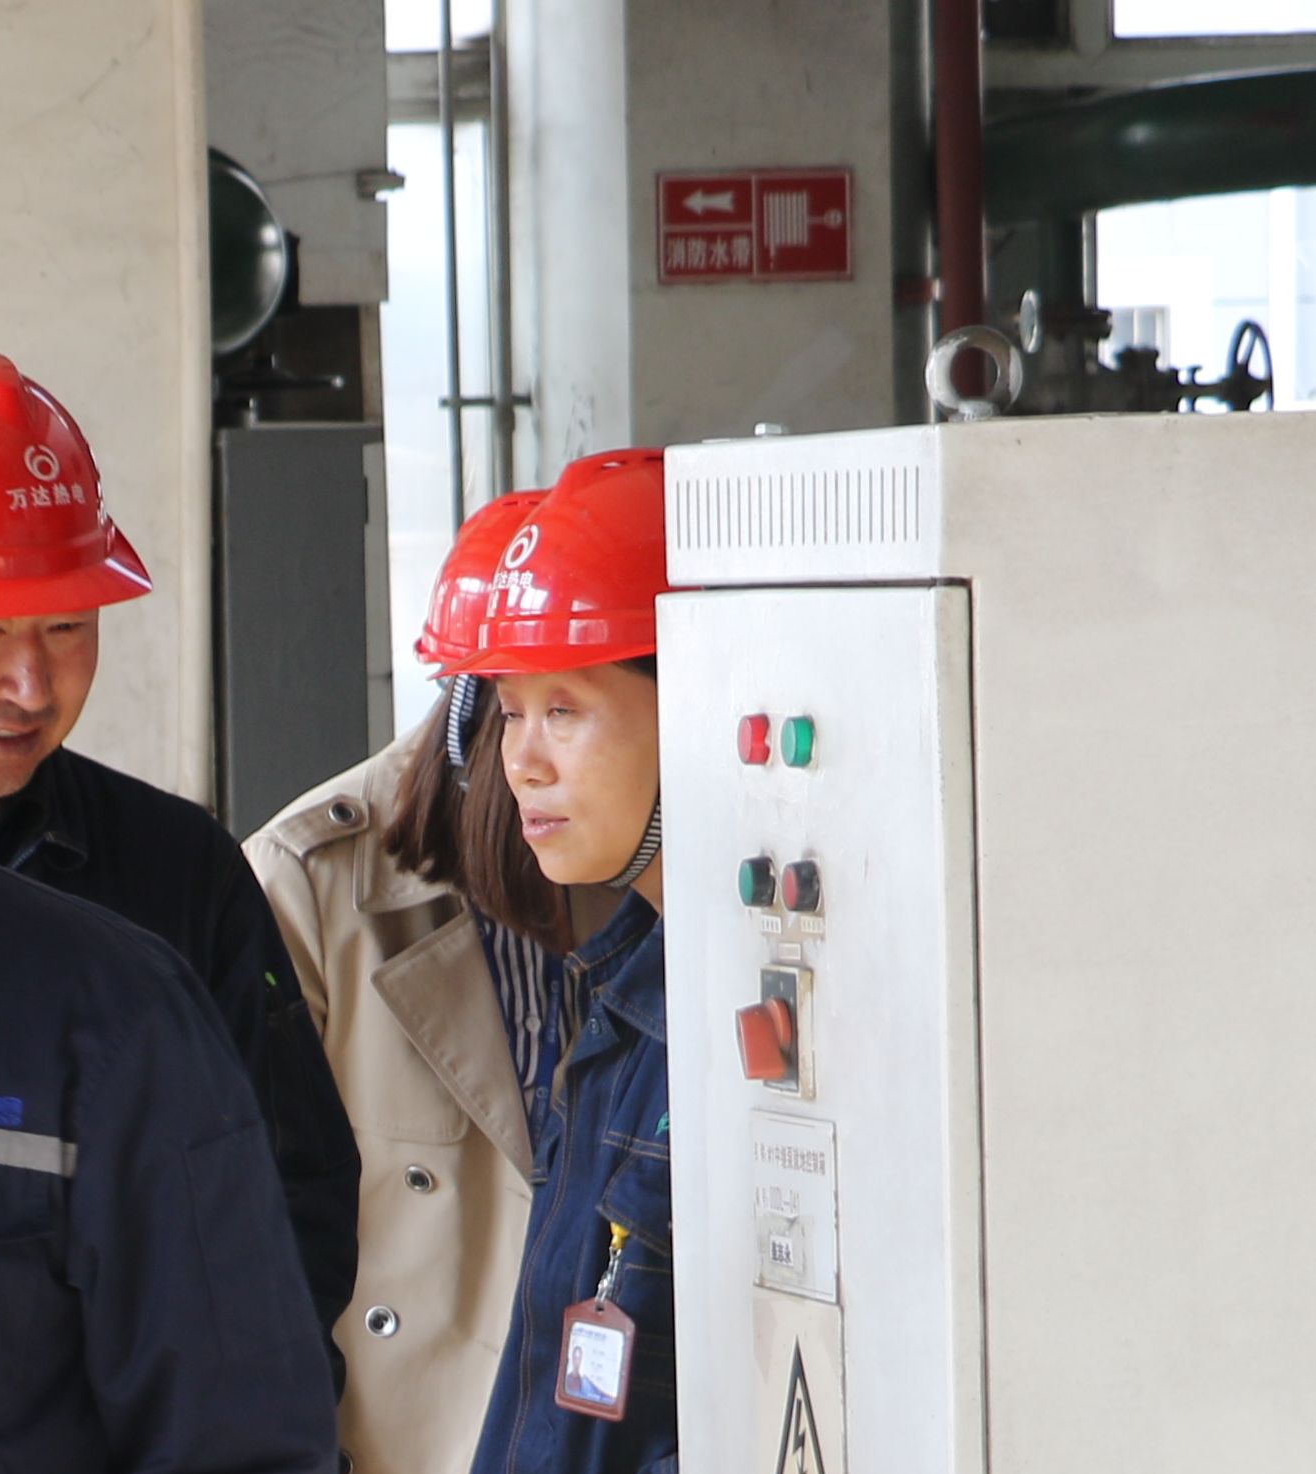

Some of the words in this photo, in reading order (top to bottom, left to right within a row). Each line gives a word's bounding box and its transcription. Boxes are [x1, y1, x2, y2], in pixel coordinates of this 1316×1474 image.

[667, 235, 751, 270] 消防水带
[5, 482, 87, 511] 万达热电
